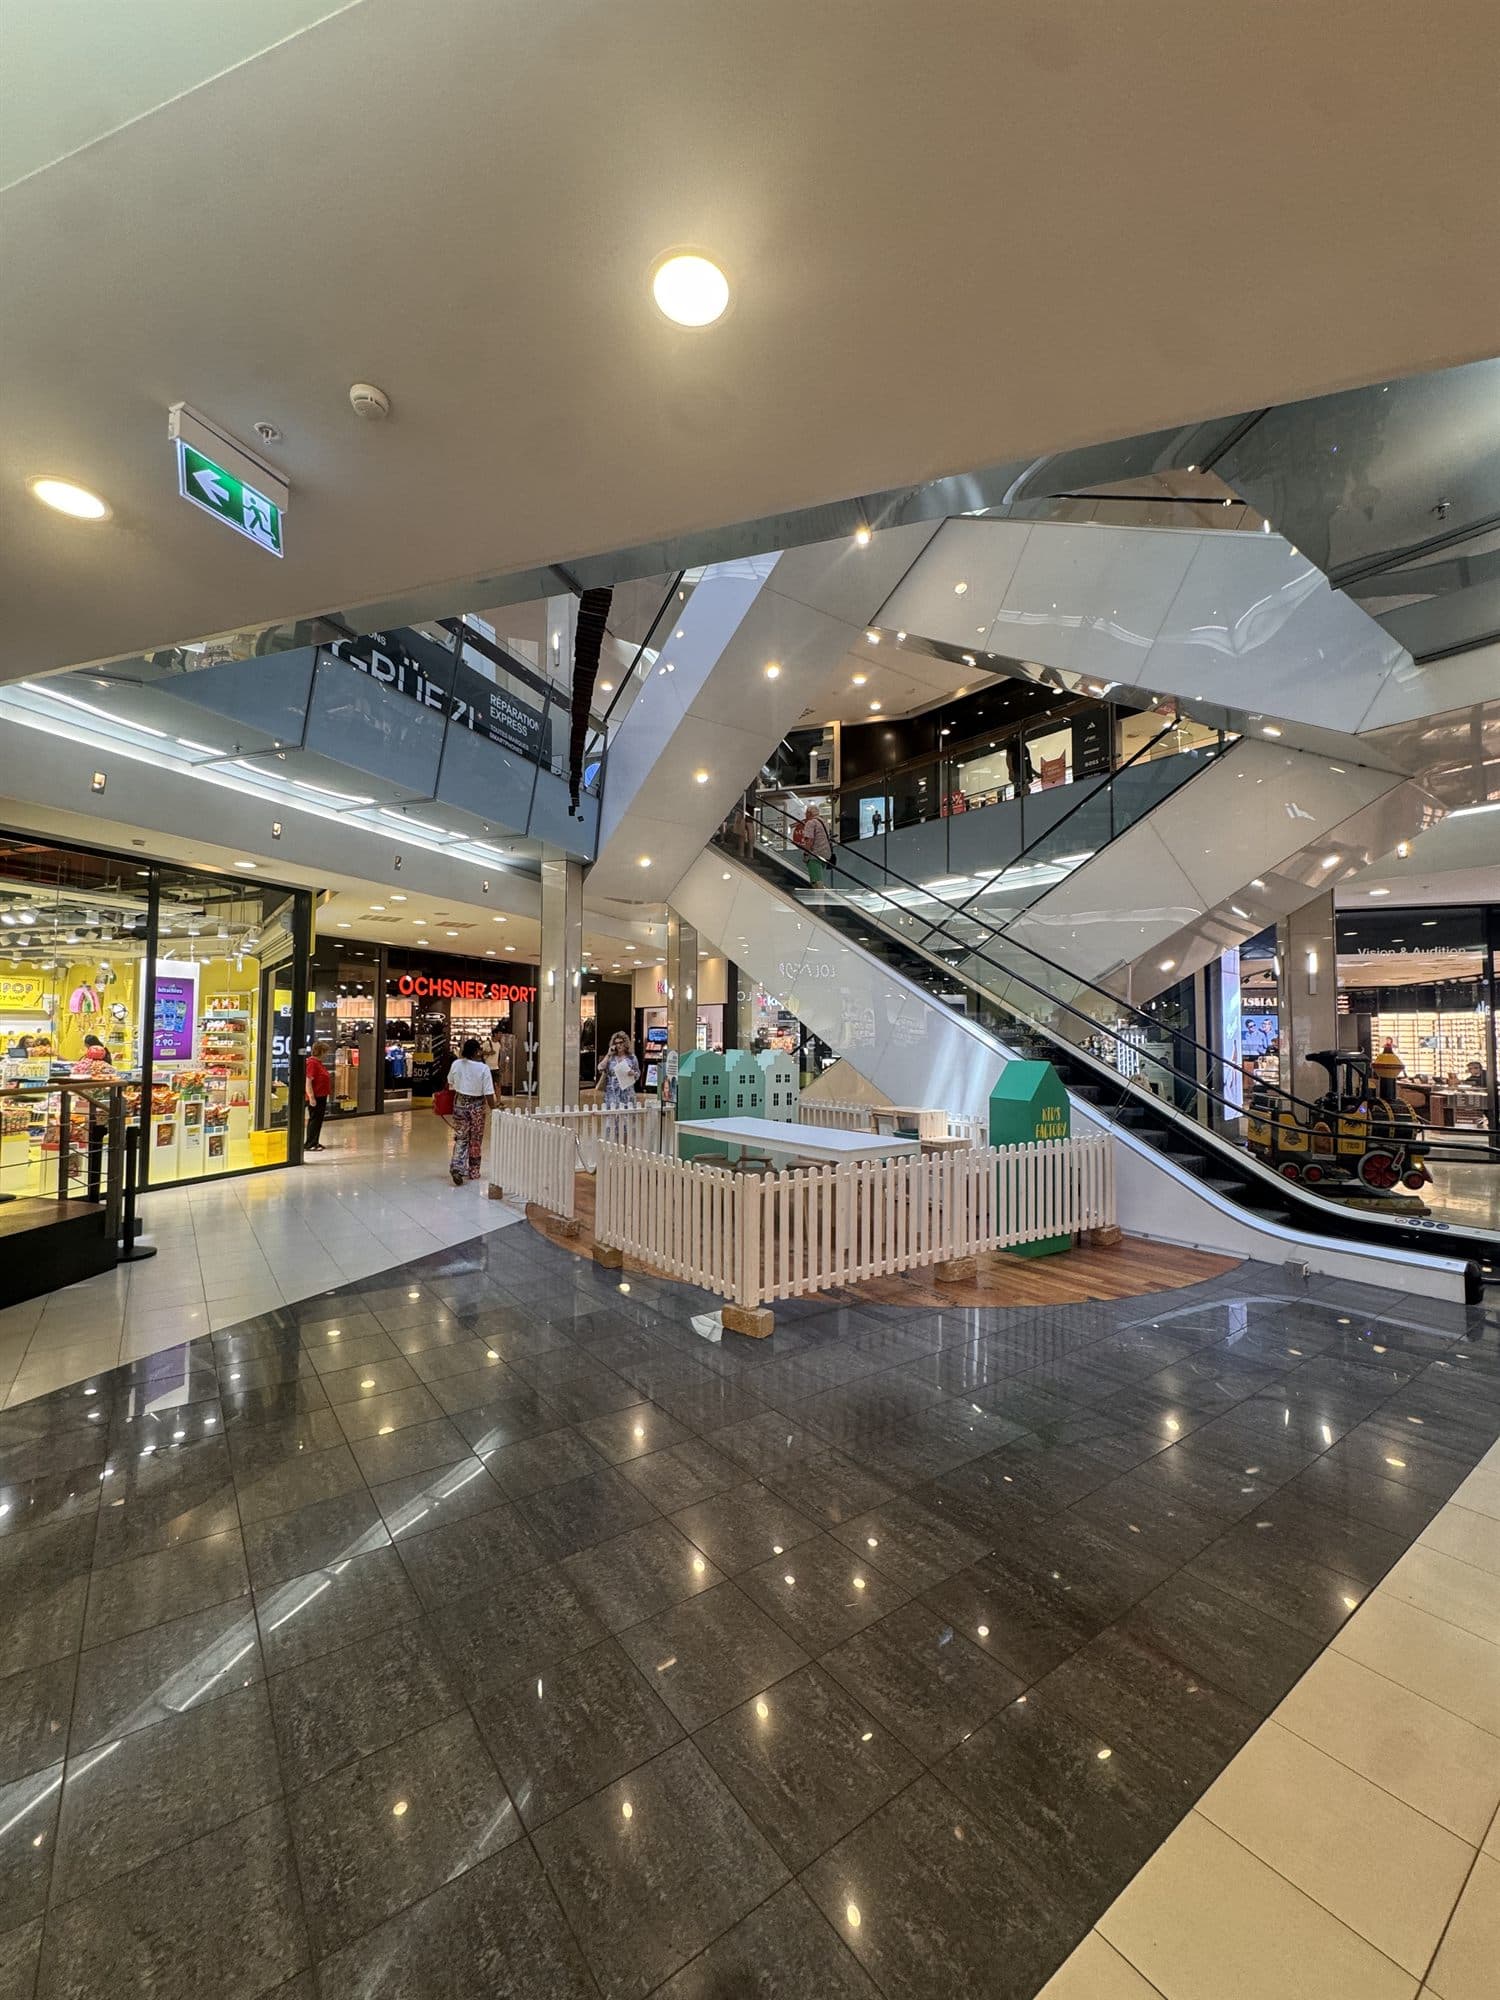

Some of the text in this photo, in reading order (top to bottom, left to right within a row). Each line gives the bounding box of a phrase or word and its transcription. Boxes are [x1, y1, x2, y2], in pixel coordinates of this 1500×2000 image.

[490, 693, 540, 731] RÉPARATION
[490, 706, 528, 736] EXPRESS
[1357, 948, 1395, 957] Vision
[1413, 945, 1467, 956] Audition
[398, 974, 537, 1003] OCHSNER SPORT
